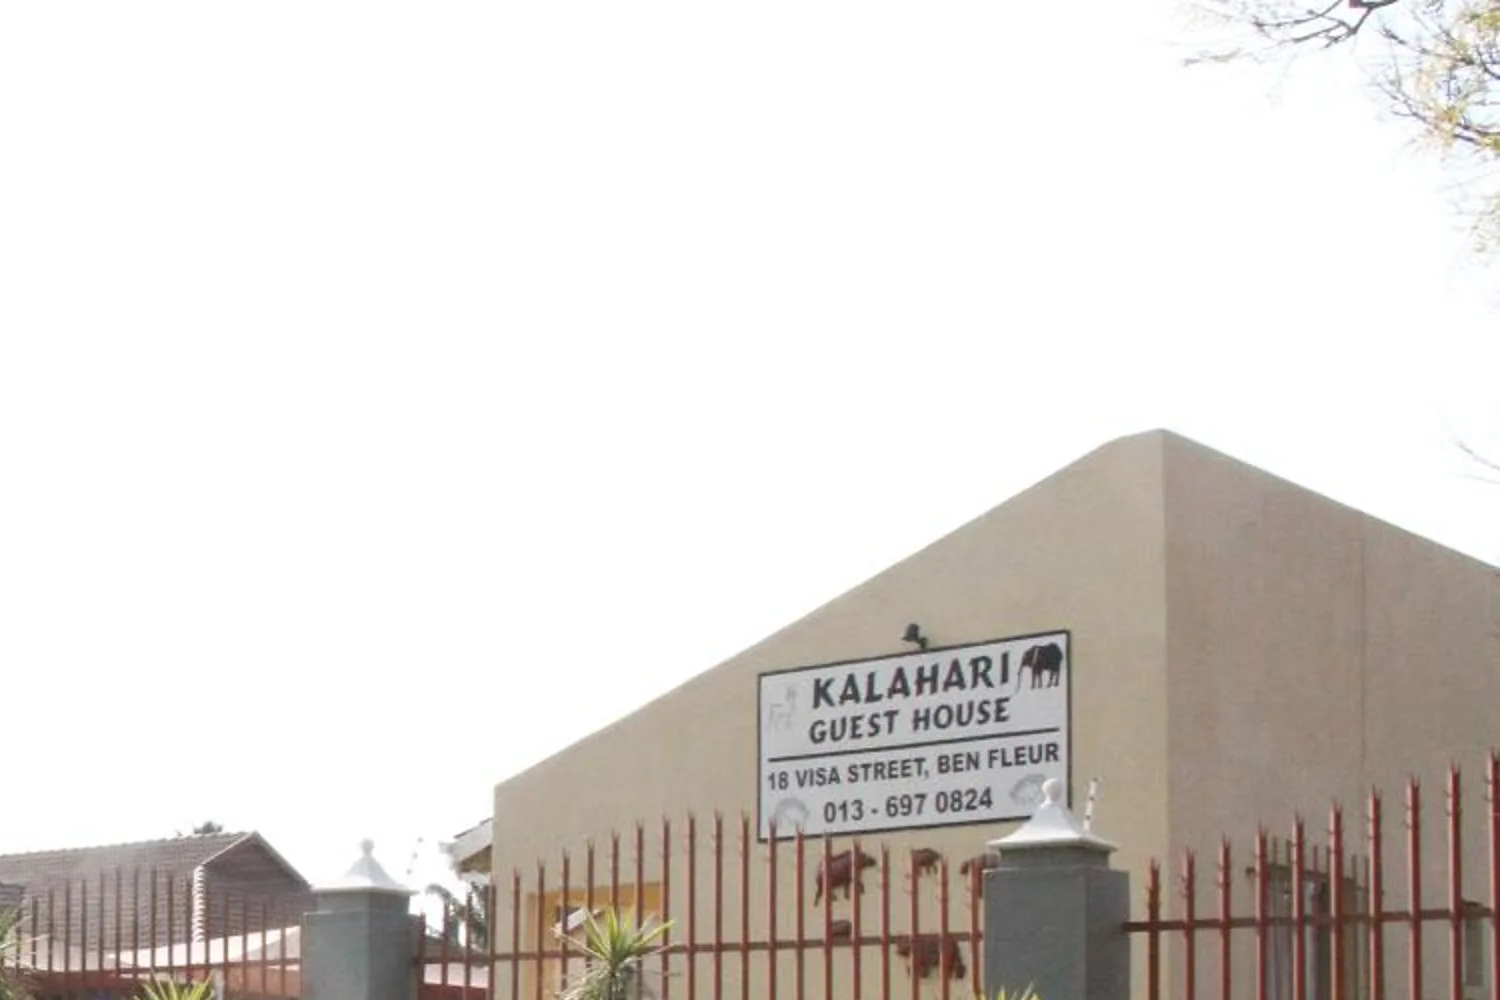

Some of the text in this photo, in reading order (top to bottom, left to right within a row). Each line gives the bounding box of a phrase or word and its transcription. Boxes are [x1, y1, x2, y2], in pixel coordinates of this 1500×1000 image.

[812, 652, 1010, 709] KALAHARI
[809, 697, 1011, 744] GUEST HOUSE
[768, 742, 1060, 790] 18 VISA STREET, BEN FLEUR
[824, 800, 864, 823] 013
[885, 793, 926, 818] 697
[935, 786, 993, 813] 0824
